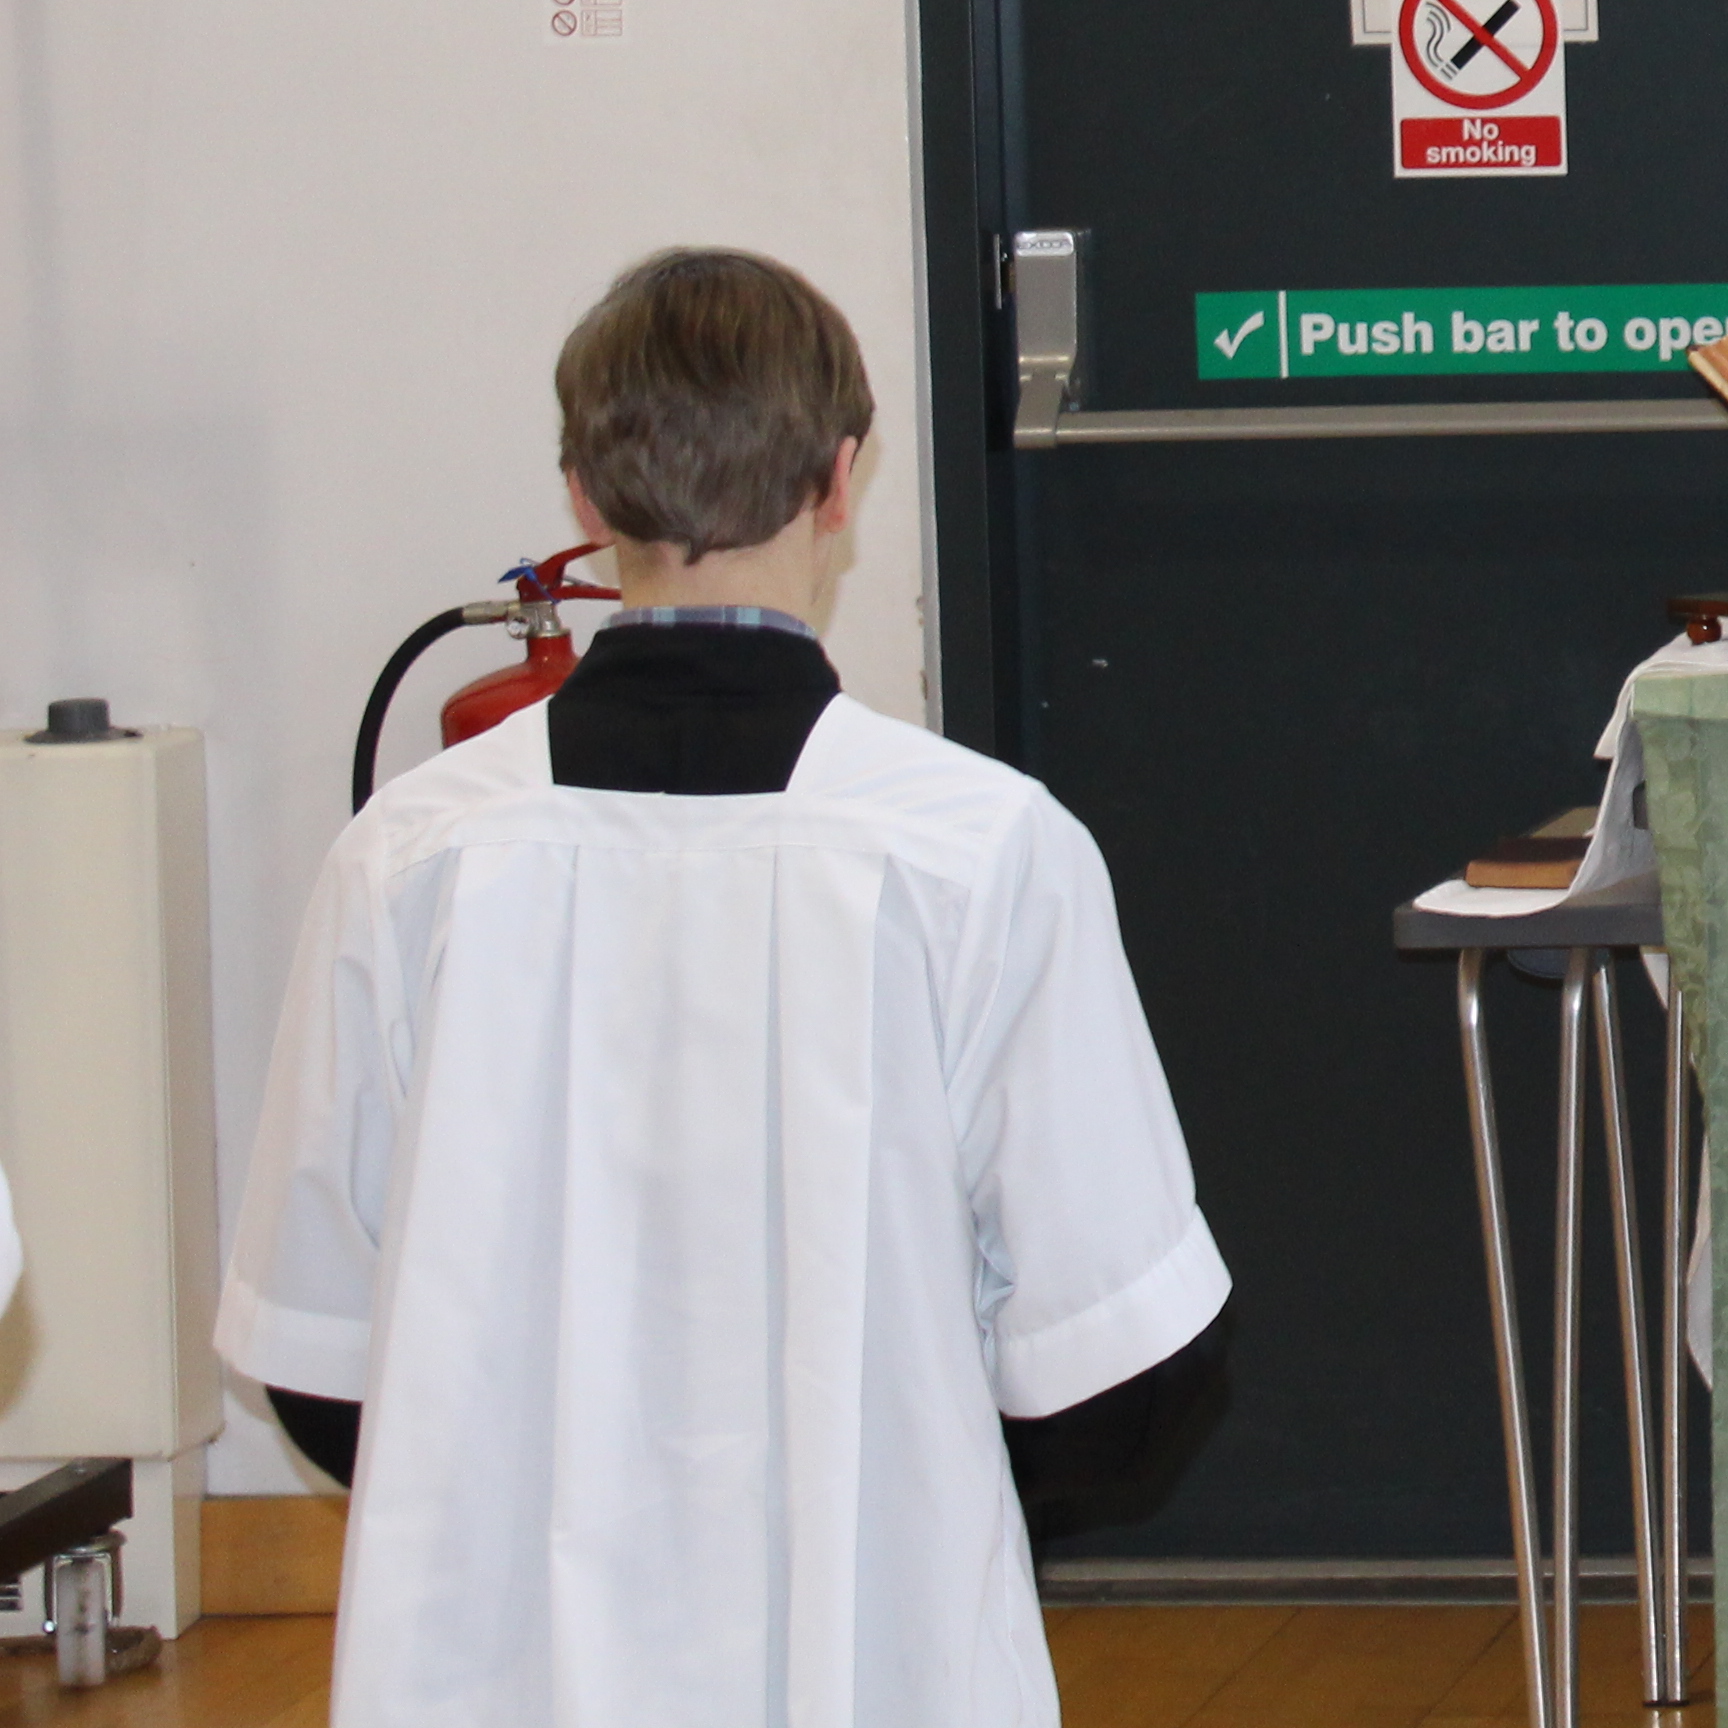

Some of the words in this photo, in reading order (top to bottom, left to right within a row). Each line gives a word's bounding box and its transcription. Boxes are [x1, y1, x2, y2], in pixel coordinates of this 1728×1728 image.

[1462, 119, 1499, 143] No
[1426, 140, 1537, 167] smoking
[1300, 312, 1434, 356] Push
[1451, 310, 1540, 353] bar
[1555, 310, 1608, 351] to
